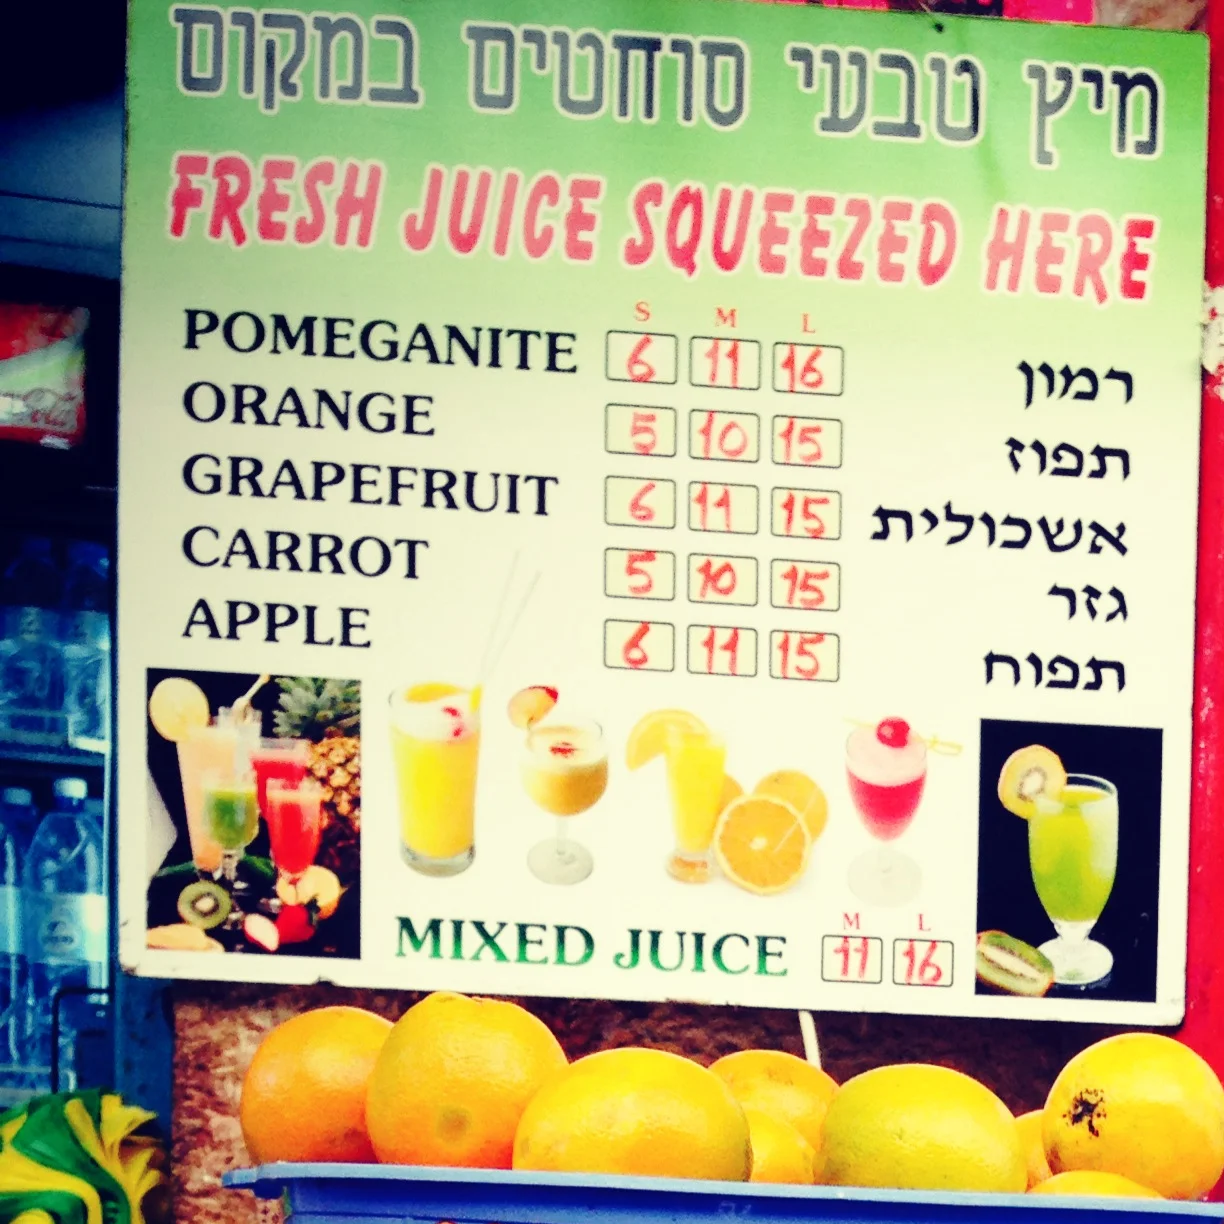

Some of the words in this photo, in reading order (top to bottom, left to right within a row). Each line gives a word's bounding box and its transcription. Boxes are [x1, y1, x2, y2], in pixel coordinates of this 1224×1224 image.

[172, 6, 422, 111] במקום
[464, 24, 746, 128] סוחטים
[788, 45, 981, 140] טבעי
[1027, 64, 1160, 165] מיץ
[169, 154, 382, 248] FRESH
[404, 168, 602, 261] JUICE
[622, 181, 958, 286] SQUEEZED
[985, 208, 1156, 305] HERE
[183, 308, 577, 374] POMEGANITE
[634, 301, 650, 323] S
[715, 306, 737, 329] M
[801, 313, 816, 335] L
[625, 332, 657, 384] 6
[704, 337, 741, 390] 11
[780, 343, 825, 395] 16
[1017, 360, 1133, 408] רמון
[183, 381, 435, 436] ORANGE
[629, 411, 659, 457] 5
[697, 409, 749, 461] 10
[778, 415, 824, 468] 15
[1005, 437, 1130, 479] תפוז
[182, 453, 559, 516] GRAPEFRUIT
[627, 480, 657, 524] 6
[692, 482, 733, 534] 11
[779, 490, 831, 541] 15
[182, 525, 429, 579] CARROT
[871, 501, 1128, 556] אשכולית
[624, 548, 658, 599] 5
[696, 557, 739, 600] 10
[779, 563, 832, 612] 15
[1048, 584, 1128, 622] גזר
[182, 598, 371, 648] APPLE
[621, 620, 652, 672] 6
[700, 625, 742, 677] 11
[776, 630, 828, 682] 15
[984, 651, 1126, 692] תפוח
[397, 916, 595, 965] MIXED
[614, 928, 787, 976] JUICE
[842, 911, 861, 930] M
[917, 912, 933, 932] L
[833, 935, 871, 979] 11
[902, 938, 944, 984] 16
